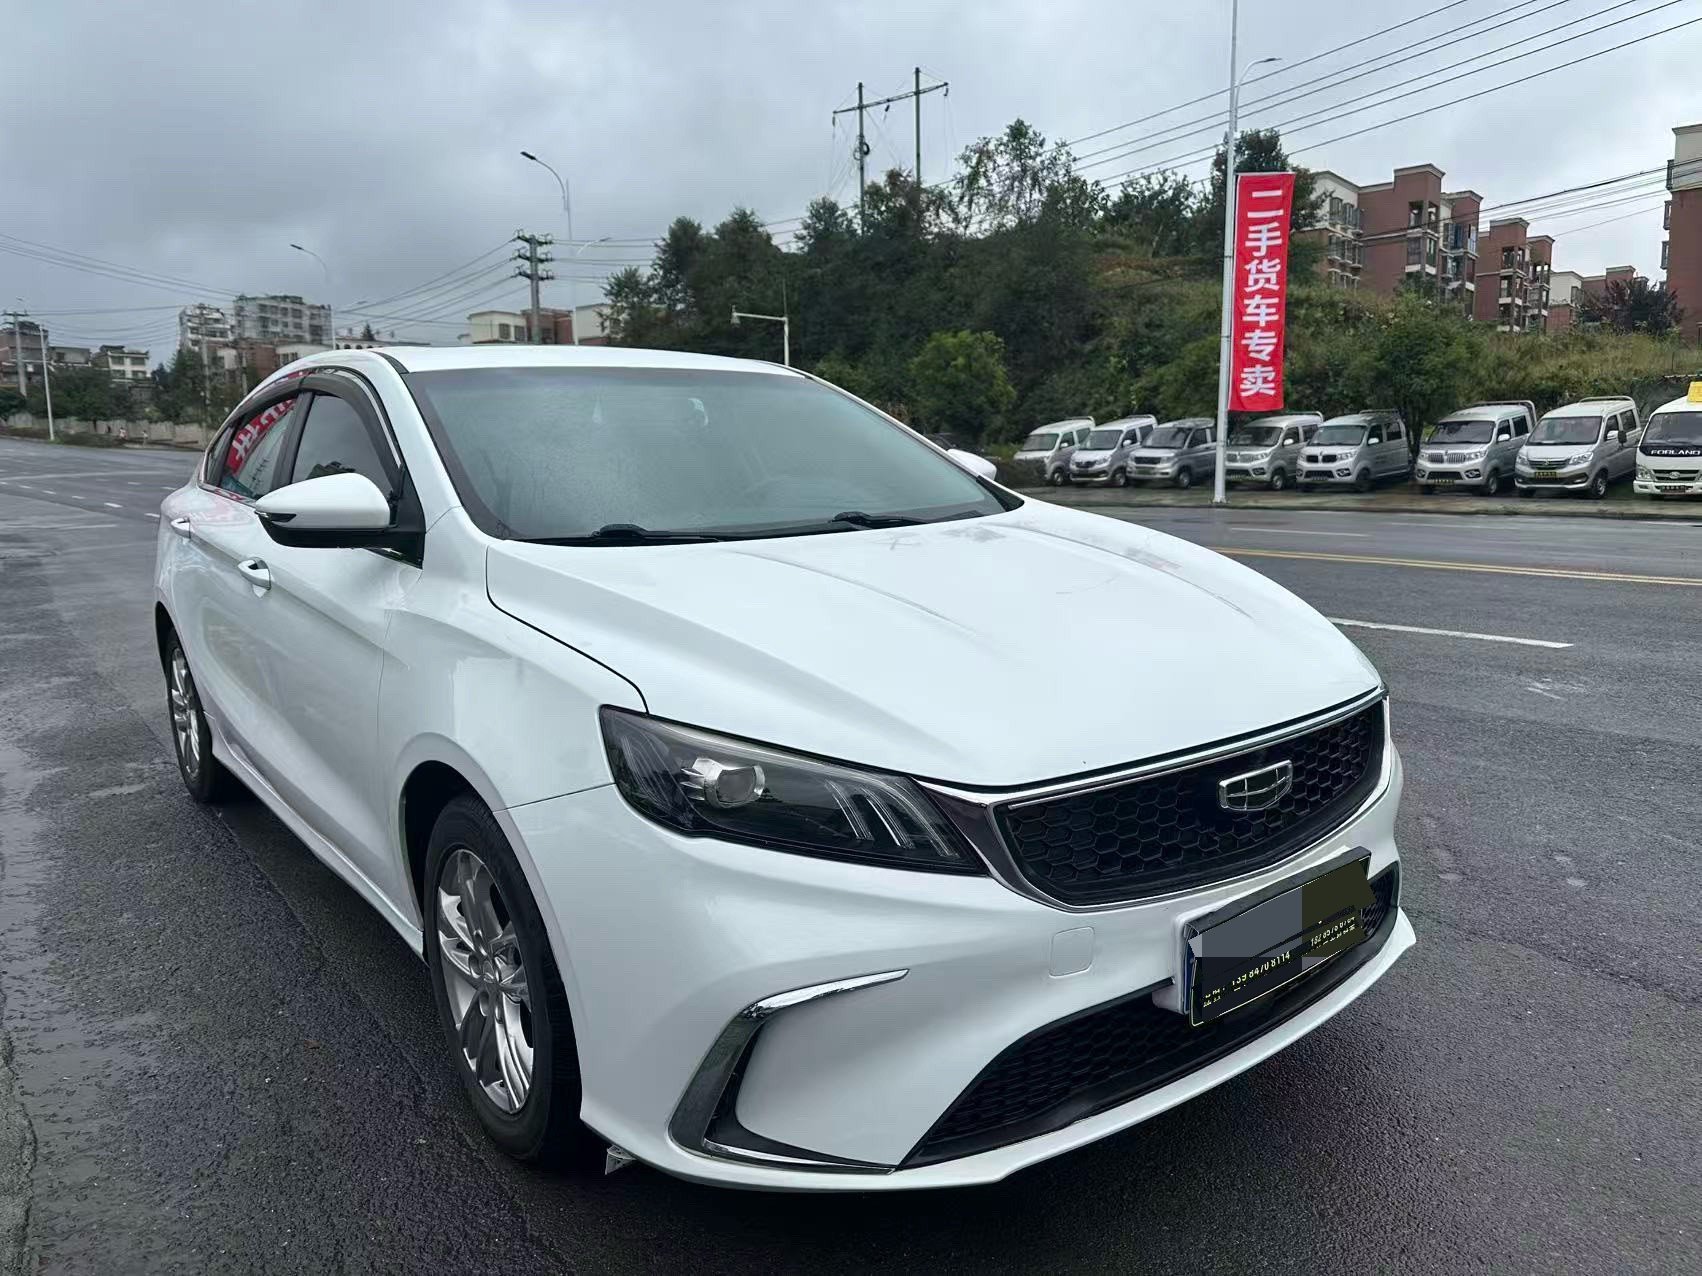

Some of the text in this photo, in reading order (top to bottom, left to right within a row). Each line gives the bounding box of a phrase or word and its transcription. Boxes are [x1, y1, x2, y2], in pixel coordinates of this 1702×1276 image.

[1240, 189, 1284, 397] 二手货车专卖
